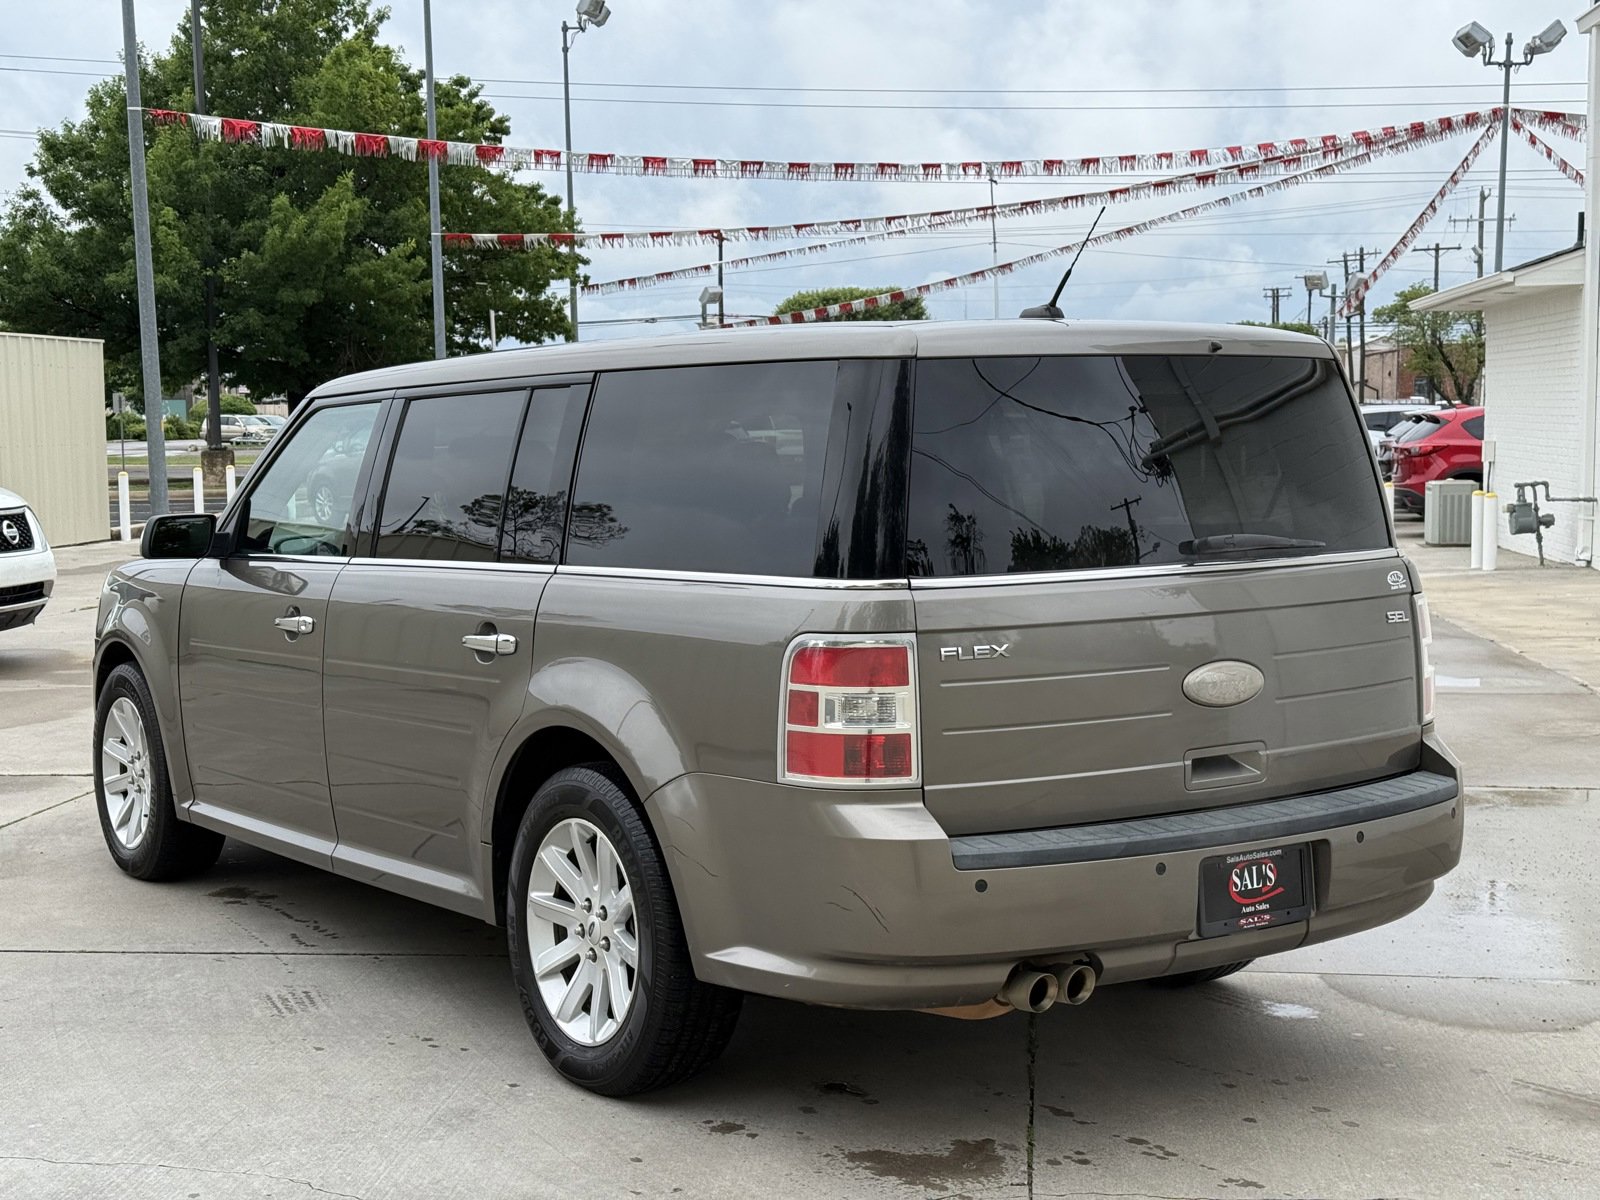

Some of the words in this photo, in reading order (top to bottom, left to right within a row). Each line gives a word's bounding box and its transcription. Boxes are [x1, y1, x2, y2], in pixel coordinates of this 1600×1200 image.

[1386, 610, 1409, 623] SEL
[940, 643, 1010, 661] FLEX
[1227, 849, 1282, 863] SalsAutoSales.com
[1232, 863, 1275, 892] SAL'S
[1241, 905, 1255, 914] Auto
[1256, 902, 1270, 911] Sales
